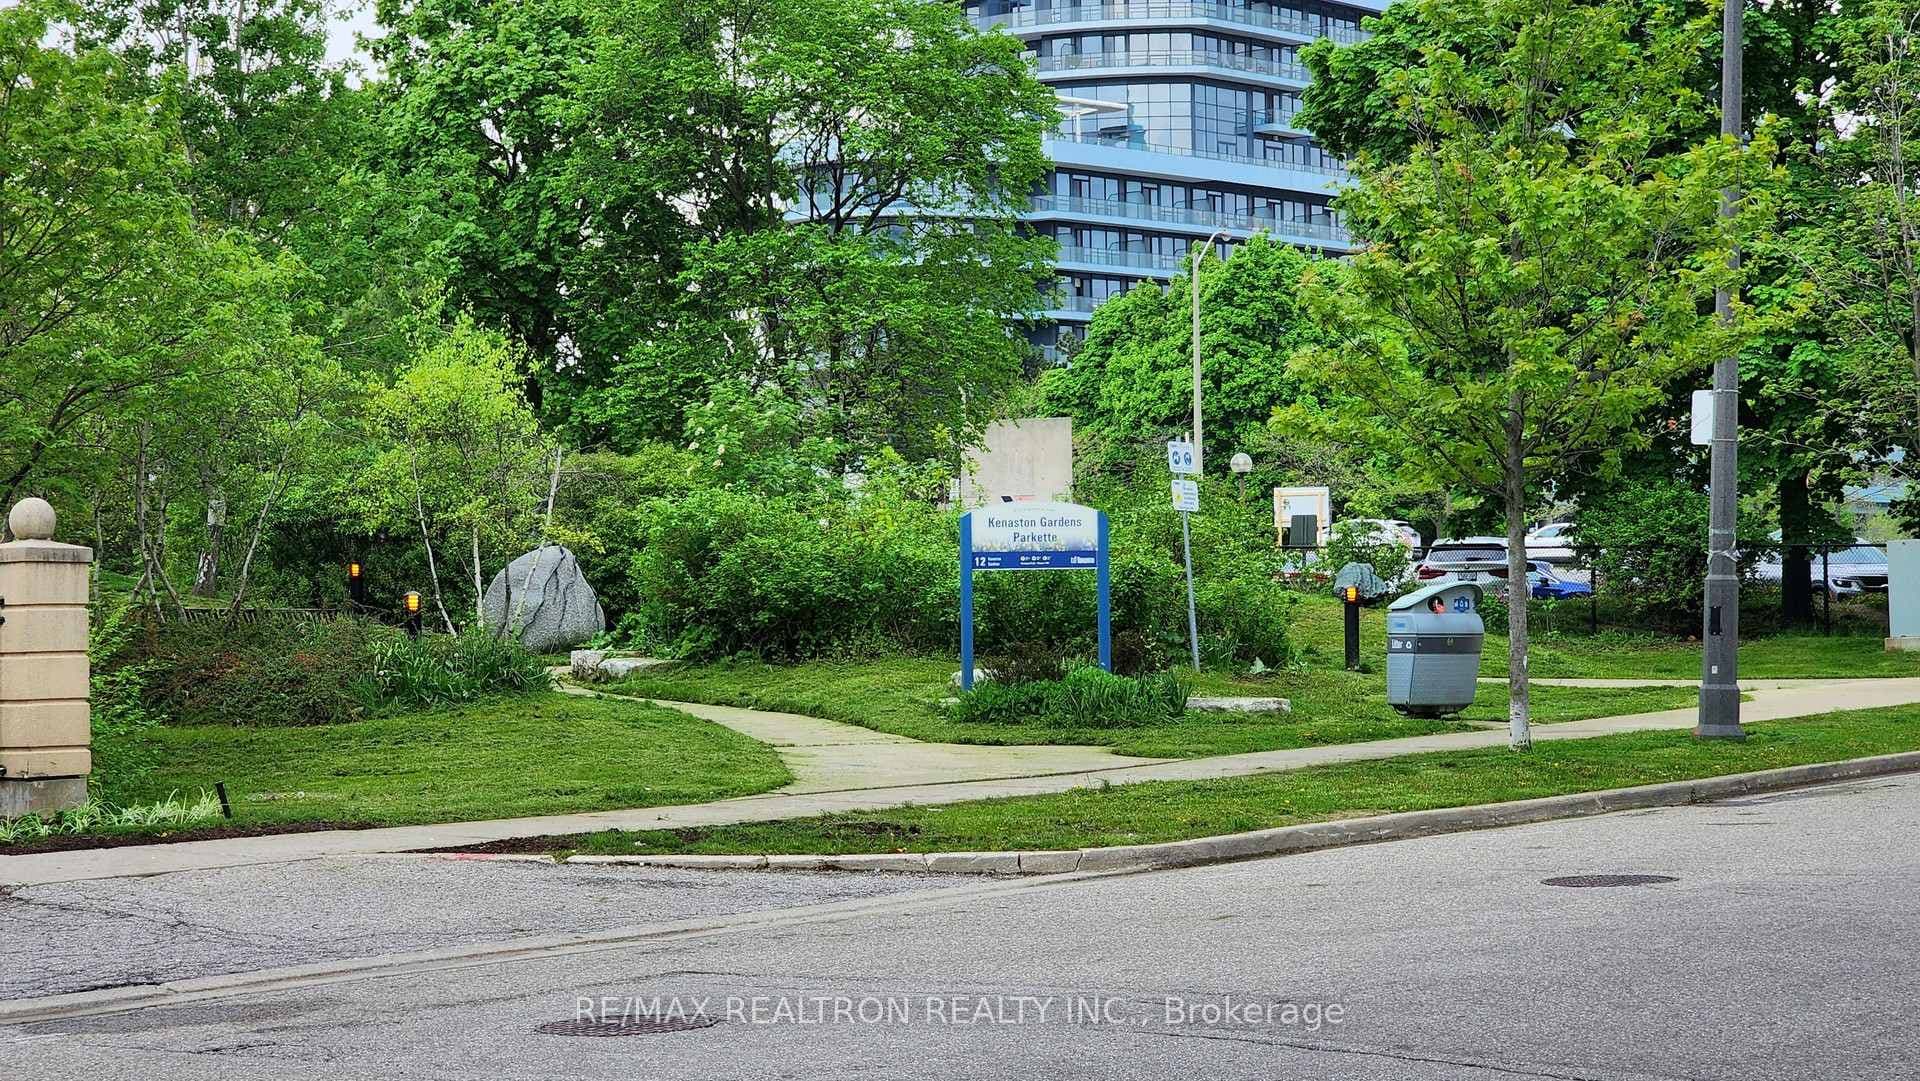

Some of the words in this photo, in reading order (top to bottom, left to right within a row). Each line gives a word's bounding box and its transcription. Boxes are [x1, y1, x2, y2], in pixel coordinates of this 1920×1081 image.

[988, 516, 1036, 528] Kenaston
[1040, 516, 1082, 528] Gardens
[1013, 532, 1058, 543] Parkette
[974, 556, 986, 567] 12
